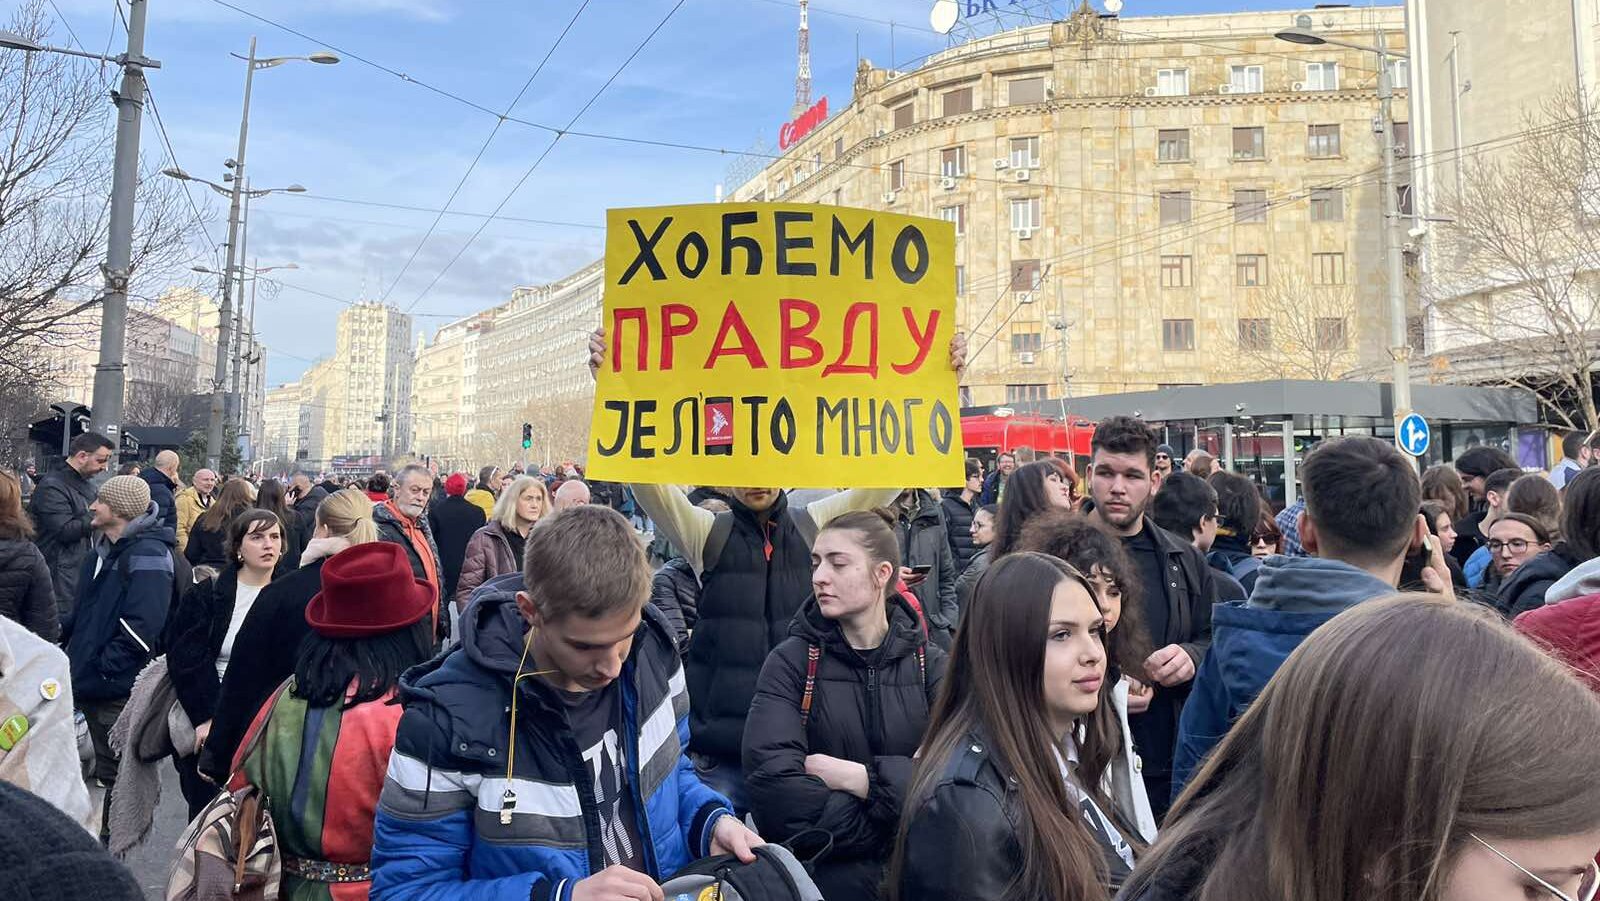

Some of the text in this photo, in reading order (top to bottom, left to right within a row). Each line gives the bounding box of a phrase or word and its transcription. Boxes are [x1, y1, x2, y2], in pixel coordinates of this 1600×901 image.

[613, 299, 940, 378] ПРАВДУ
[741, 396, 796, 455] ТО
[816, 397, 952, 456] МНОГО
